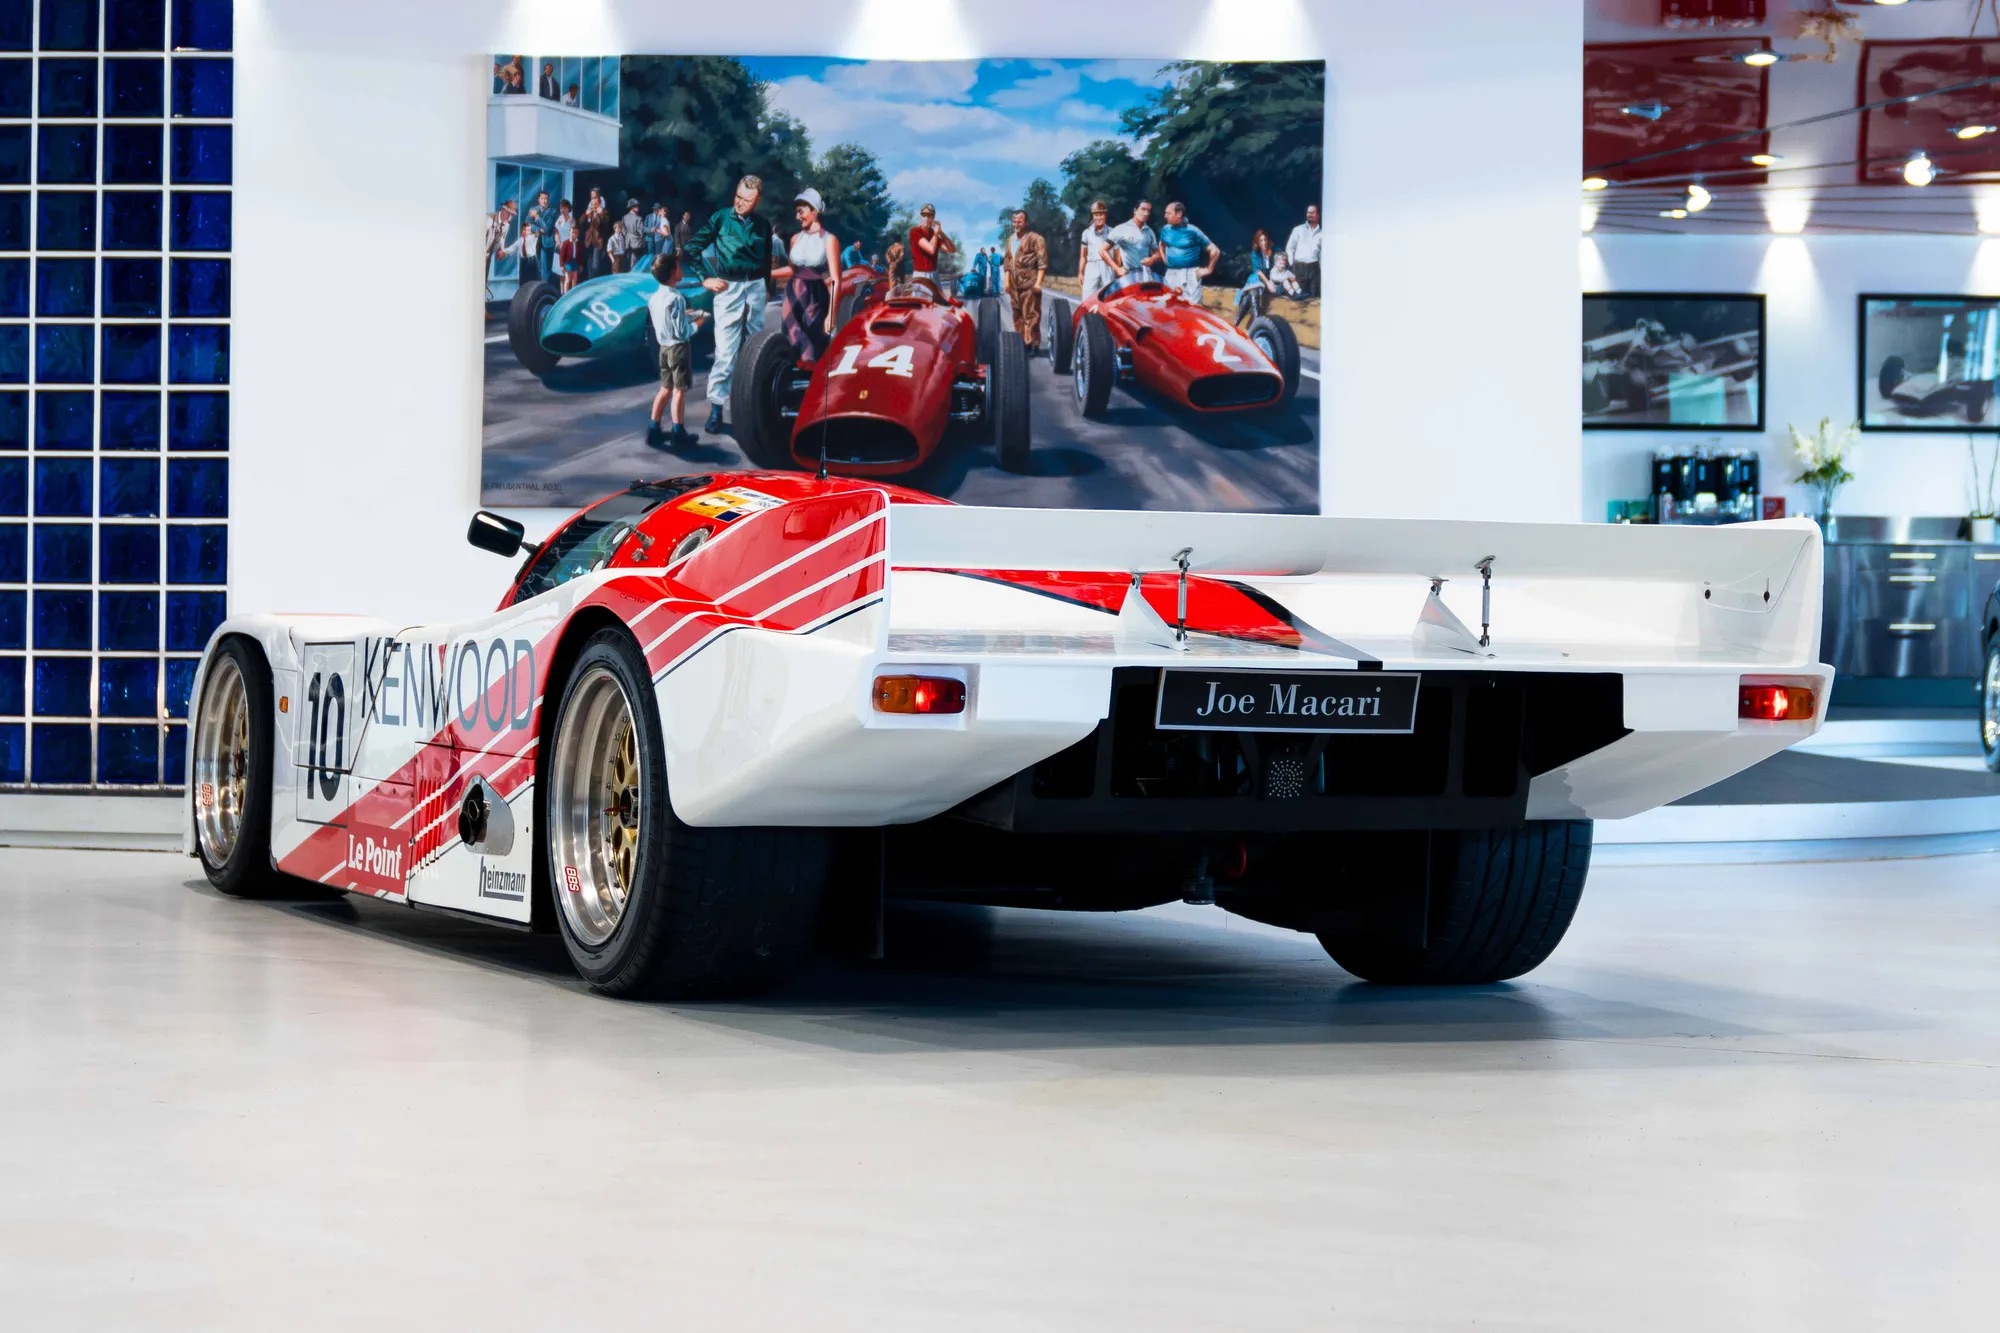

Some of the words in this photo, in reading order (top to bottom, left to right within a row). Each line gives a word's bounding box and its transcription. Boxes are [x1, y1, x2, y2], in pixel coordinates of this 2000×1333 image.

[581, 302, 621, 330] 18
[828, 344, 915, 378] 14
[1197, 333, 1241, 363] 2
[361, 636, 536, 733] KENWOOD
[1197, 681, 1255, 717] Joe
[1265, 683, 1381, 717] Macari
[306, 671, 345, 802] 10
[202, 783, 214, 808] BBS
[348, 834, 363, 870] Le
[365, 836, 402, 880] Point
[478, 855, 526, 897] heinzmann
[565, 866, 580, 893] BBS
